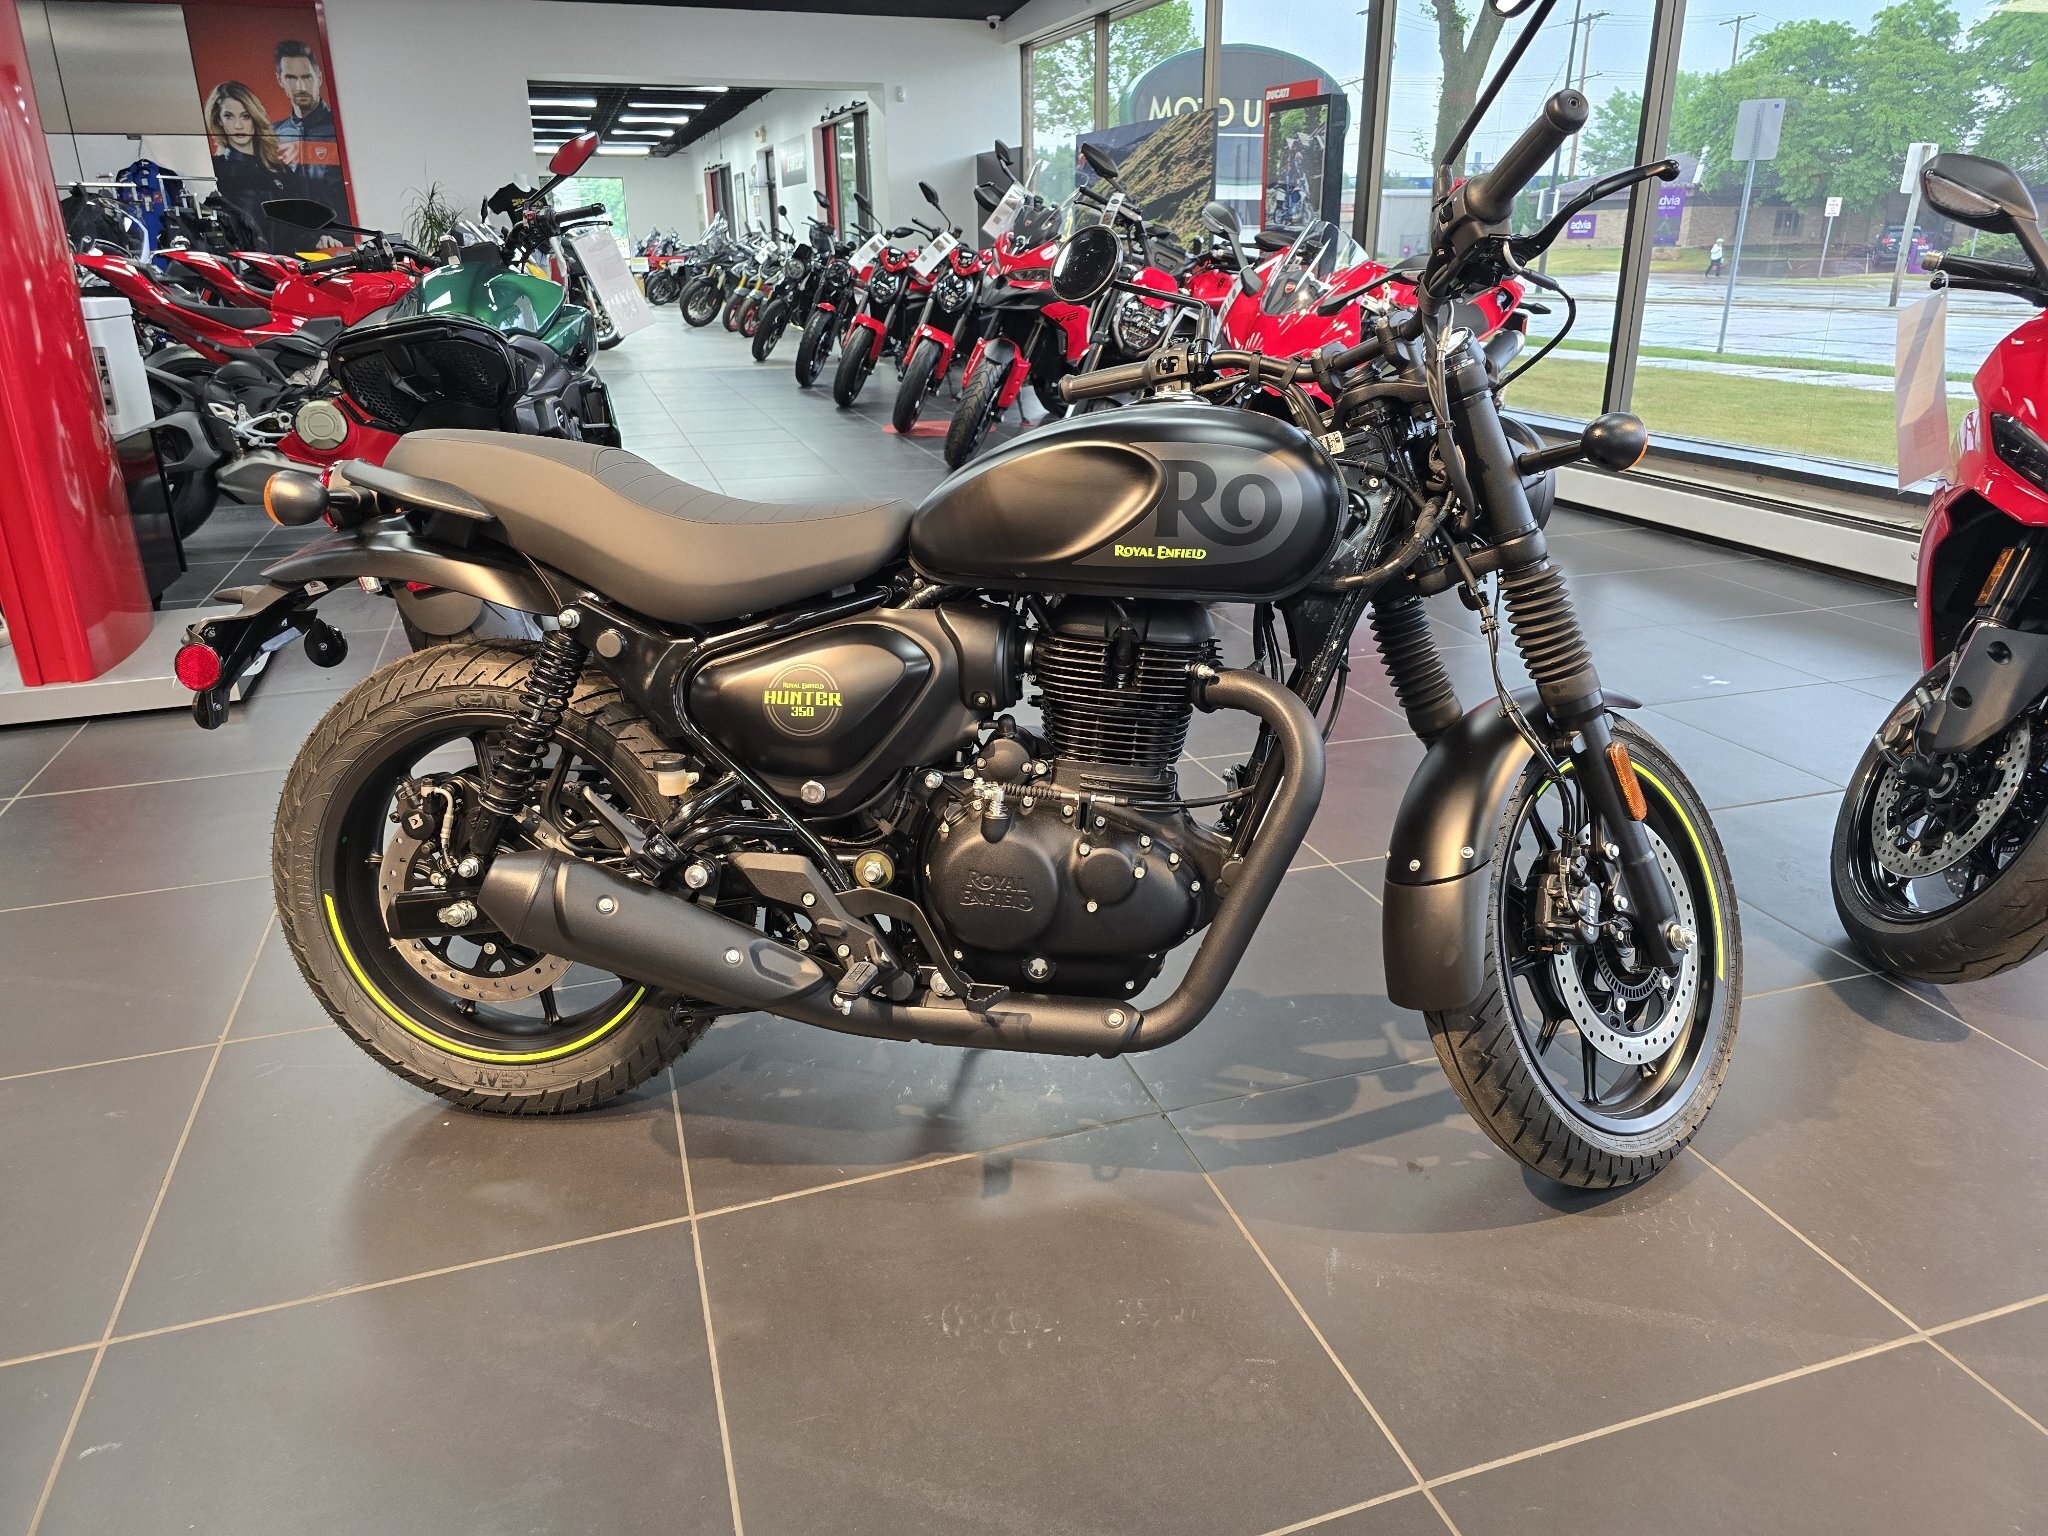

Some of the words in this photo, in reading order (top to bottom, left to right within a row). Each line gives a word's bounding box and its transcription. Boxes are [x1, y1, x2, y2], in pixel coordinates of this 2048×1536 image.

[1149, 95, 1234, 127] MOO
[1243, 99, 1264, 127] U
[1570, 220, 1592, 229] advia
[1115, 545, 1155, 558] ROYAL
[1157, 546, 1207, 560] ENFIELD
[782, 681, 801, 689] ROYAL
[455, 692, 510, 709] CEAT
[764, 690, 843, 707] HUNTER
[791, 706, 815, 717] 350
[966, 868, 1028, 892] ROYAL
[959, 889, 1034, 912] ENFIELD
